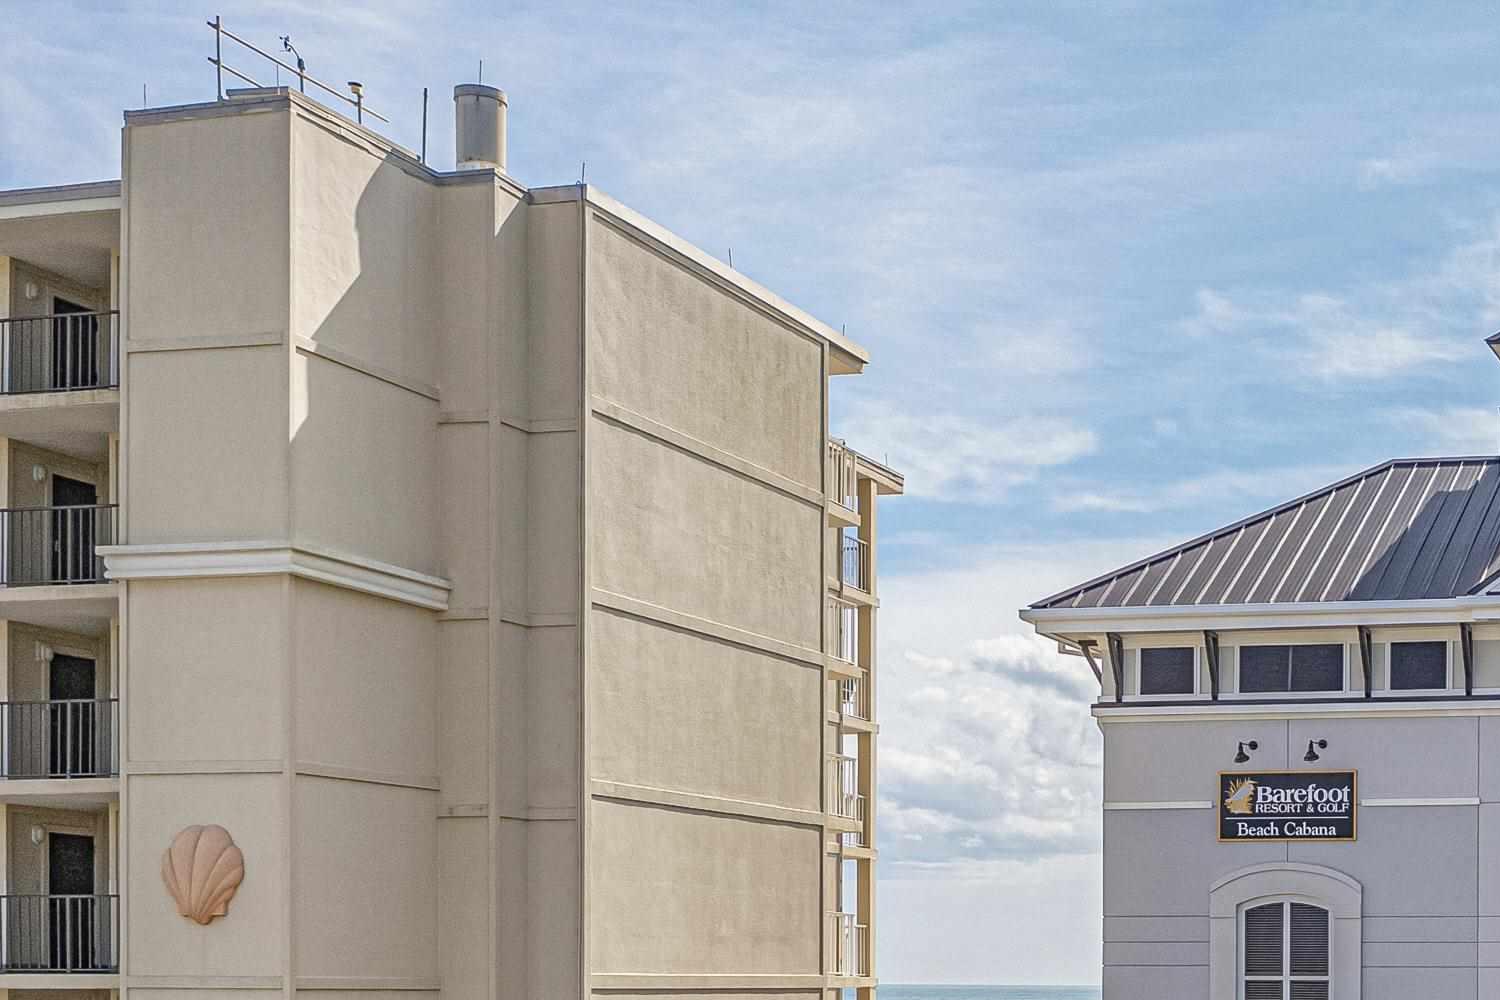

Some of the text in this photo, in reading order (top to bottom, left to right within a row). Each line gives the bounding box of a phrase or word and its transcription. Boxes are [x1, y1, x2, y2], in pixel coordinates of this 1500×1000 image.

[1256, 784, 1350, 803] Barefoot
[1255, 802, 1349, 814] RESORT & GOLF
[1236, 821, 1336, 837] Beach Cabana
